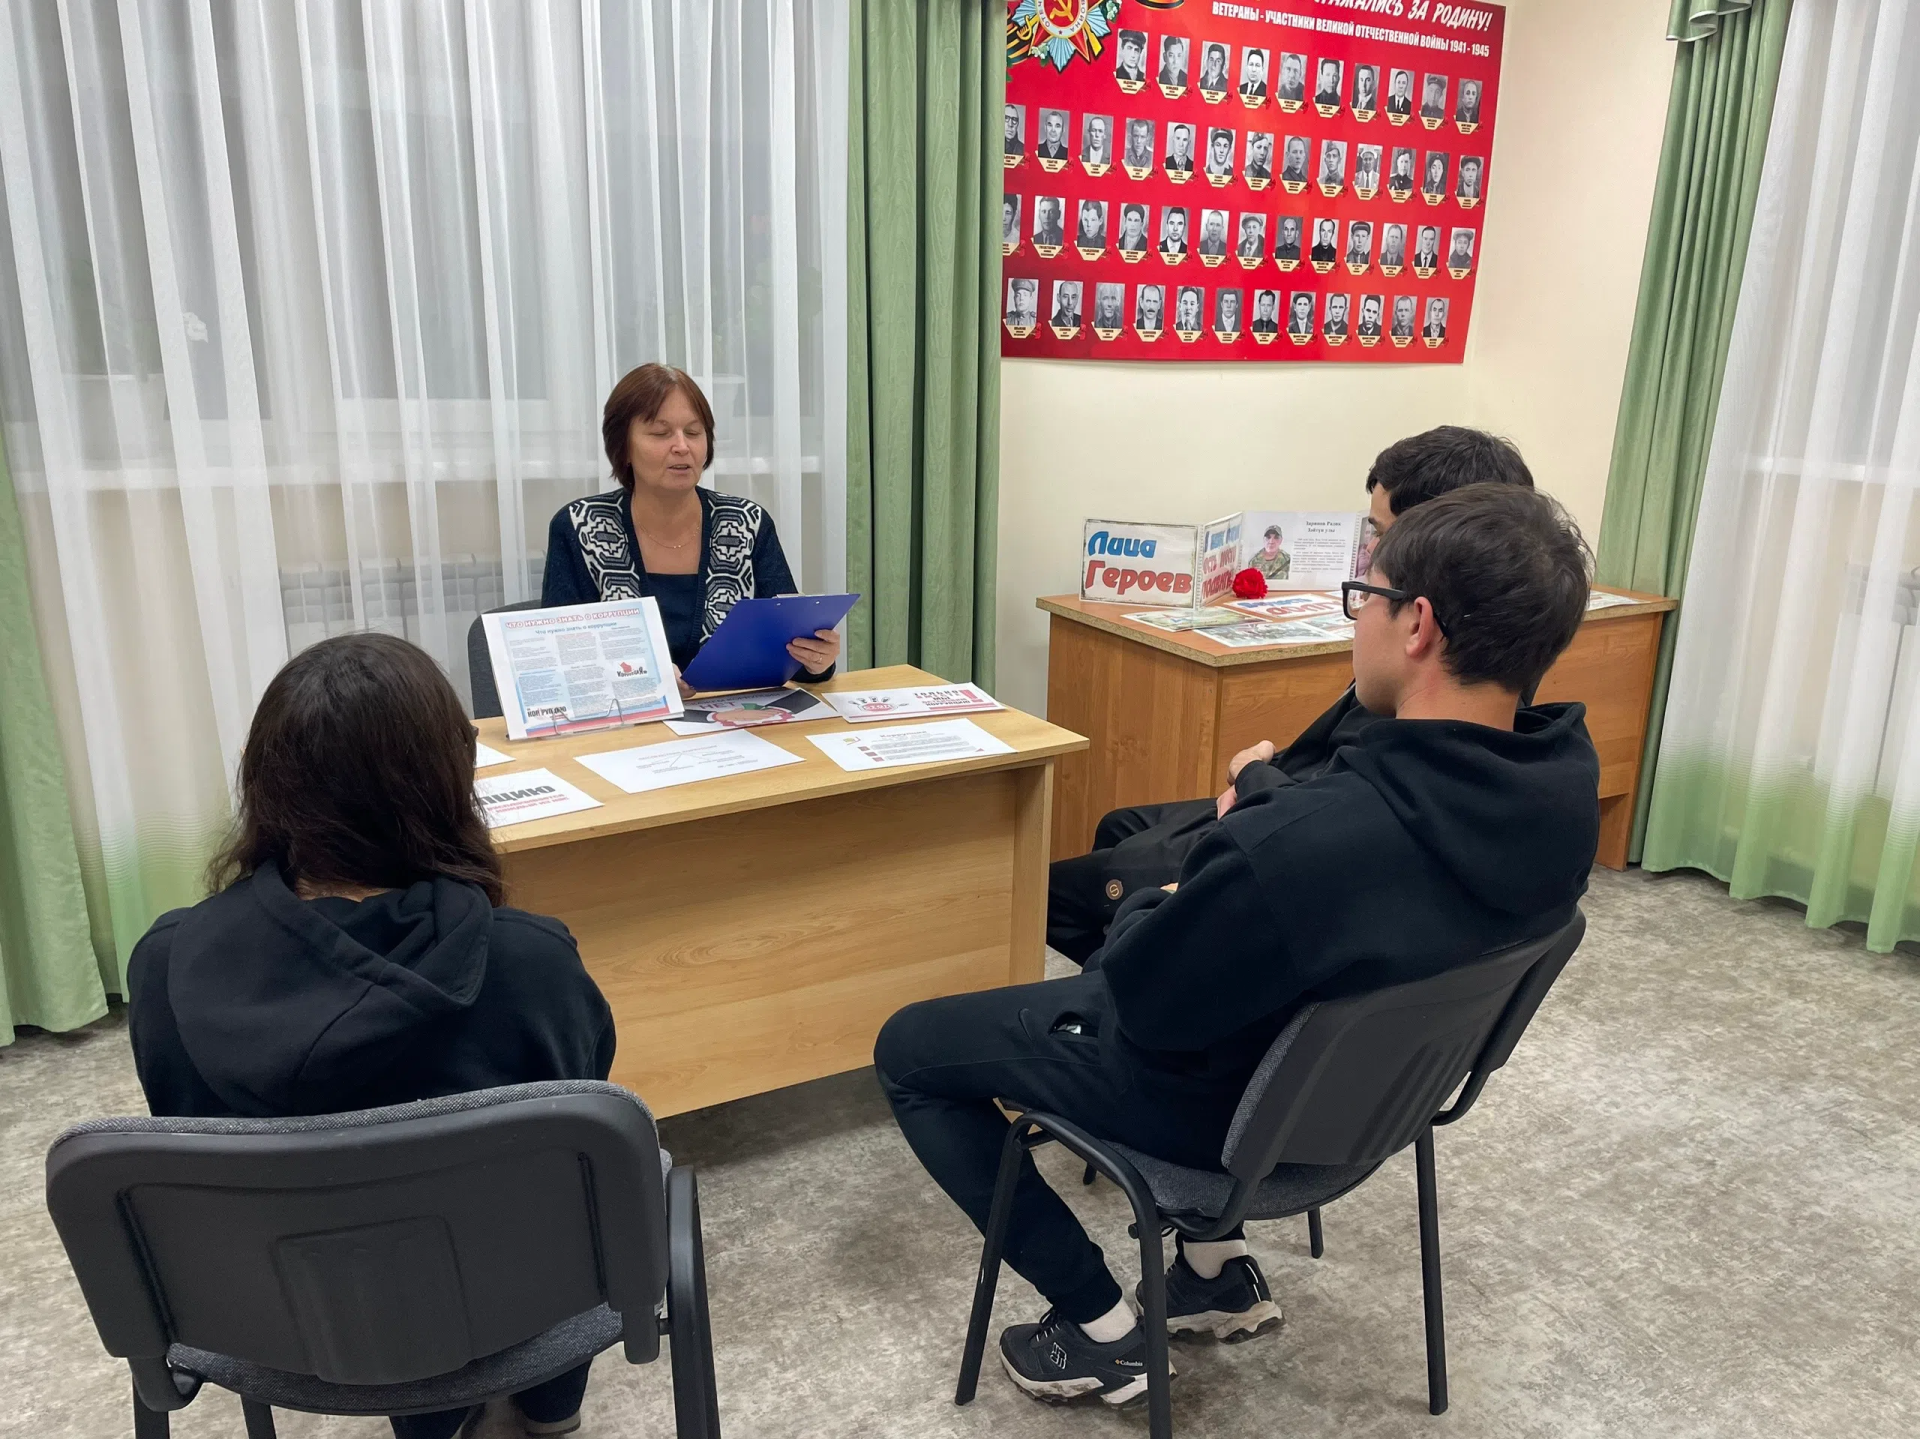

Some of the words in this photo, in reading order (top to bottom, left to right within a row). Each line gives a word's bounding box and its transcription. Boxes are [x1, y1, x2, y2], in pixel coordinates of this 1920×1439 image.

[1212, 1, 1259, 21] ВЕТЕРАНЫ
[1265, 9, 1315, 30] УЧАСТНИКИ
[1316, 18, 1355, 37] ВЕЛИКОЙ
[1355, 25, 1420, 46] ОТЕЧЕСТВЕННОЙ
[1420, 34, 1449, 51] ВОЙНЫ
[1450, 40, 1467, 54] 1941
[1471, 44, 1490, 57] 1945
[1312, 0, 1404, 17] АЛИСЬ
[1407, 0, 1430, 20] ЗА
[1431, 3, 1493, 32] РОДИНУ!
[1088, 531, 1157, 559] Лица
[1085, 560, 1193, 595] Героев
[504, 621, 524, 629] ЧТО
[524, 618, 556, 627] НУЖНО
[556, 614, 583, 624] ЗНАТЬ
[592, 608, 640, 620] КОРРУПЦИИ
[699, 702, 735, 710] НЕТ
